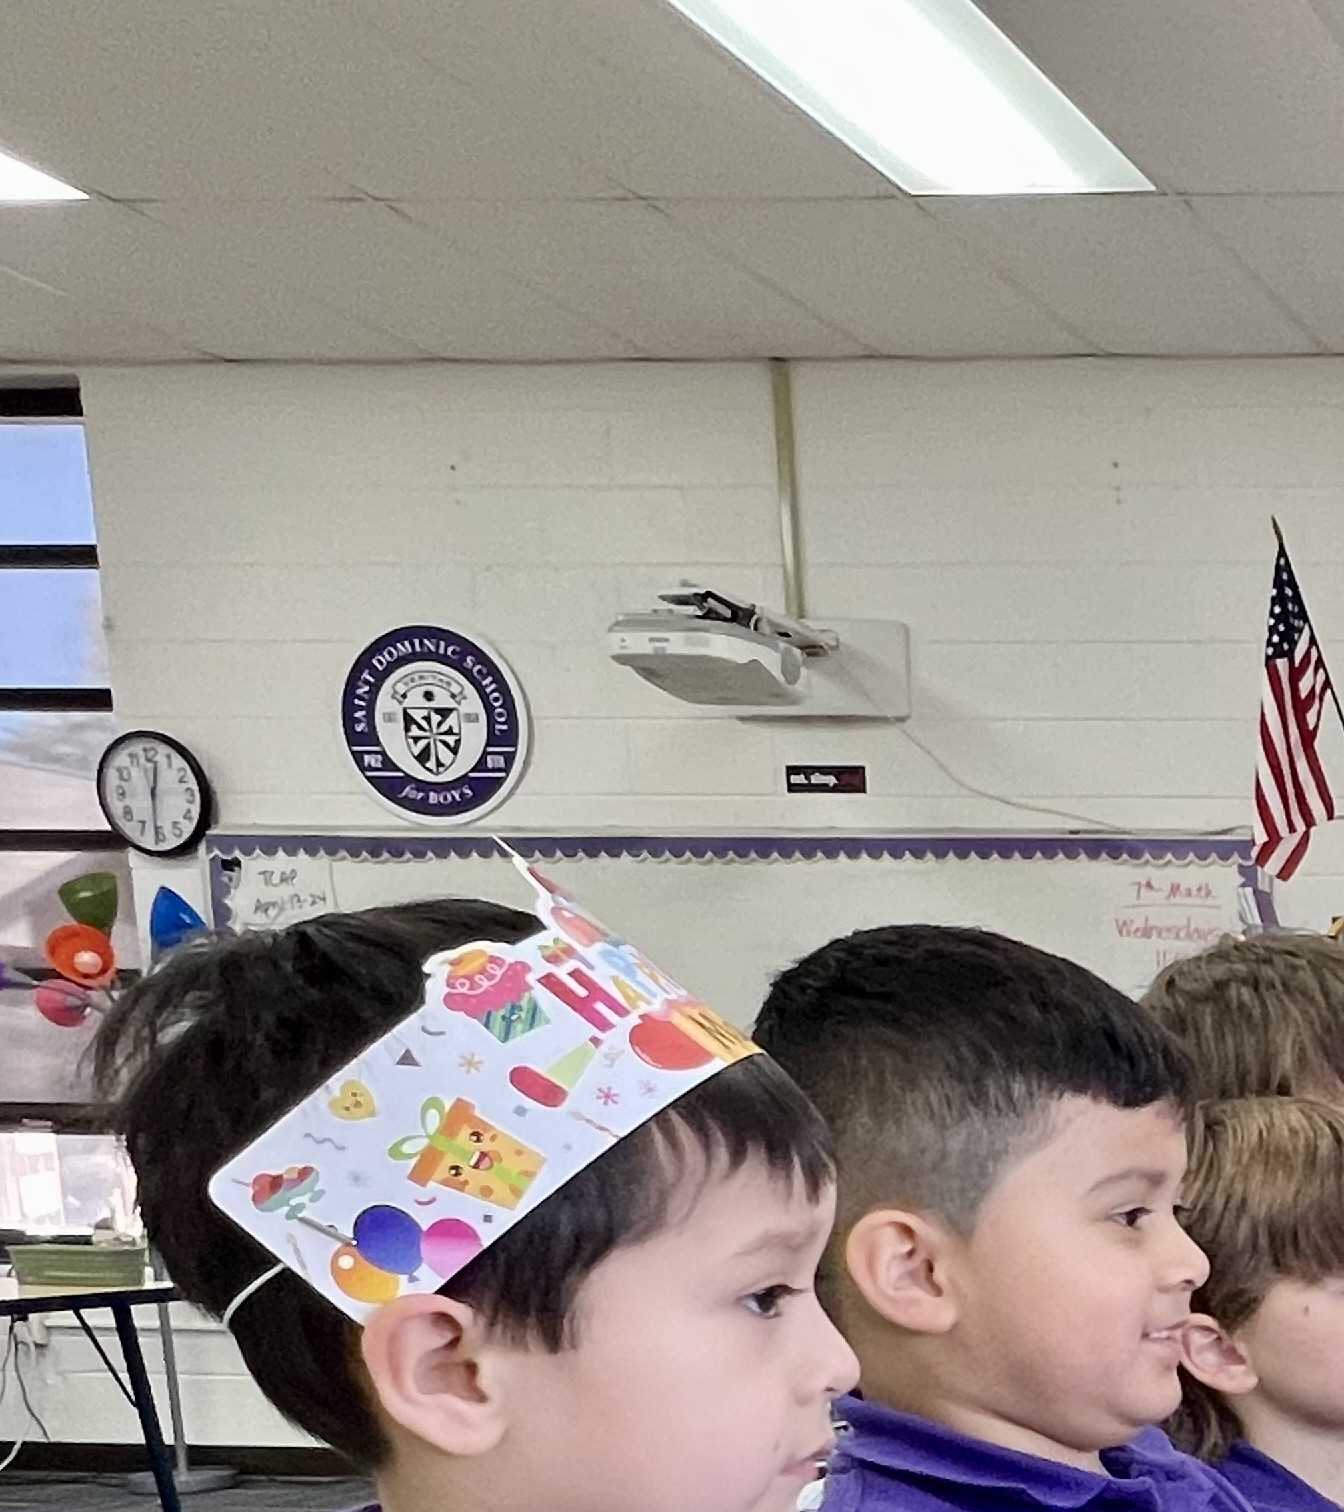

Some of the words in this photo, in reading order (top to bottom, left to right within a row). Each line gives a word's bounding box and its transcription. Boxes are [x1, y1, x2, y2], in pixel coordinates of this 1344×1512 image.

[352, 669, 376, 734] SAINT
[371, 638, 461, 672] DOMINIC
[463, 654, 509, 735] SCHOOL
[128, 753, 140, 768] 11
[142, 747, 159, 763] 12
[165, 753, 173, 769] 1
[177, 767, 188, 784] 2
[116, 784, 126, 801] 9
[184, 787, 195, 805] 3
[428, 784, 474, 804] BOYS
[122, 804, 134, 822] 8
[182, 808, 194, 824] 4
[137, 820, 147, 837] 7
[171, 820, 183, 838] 5
